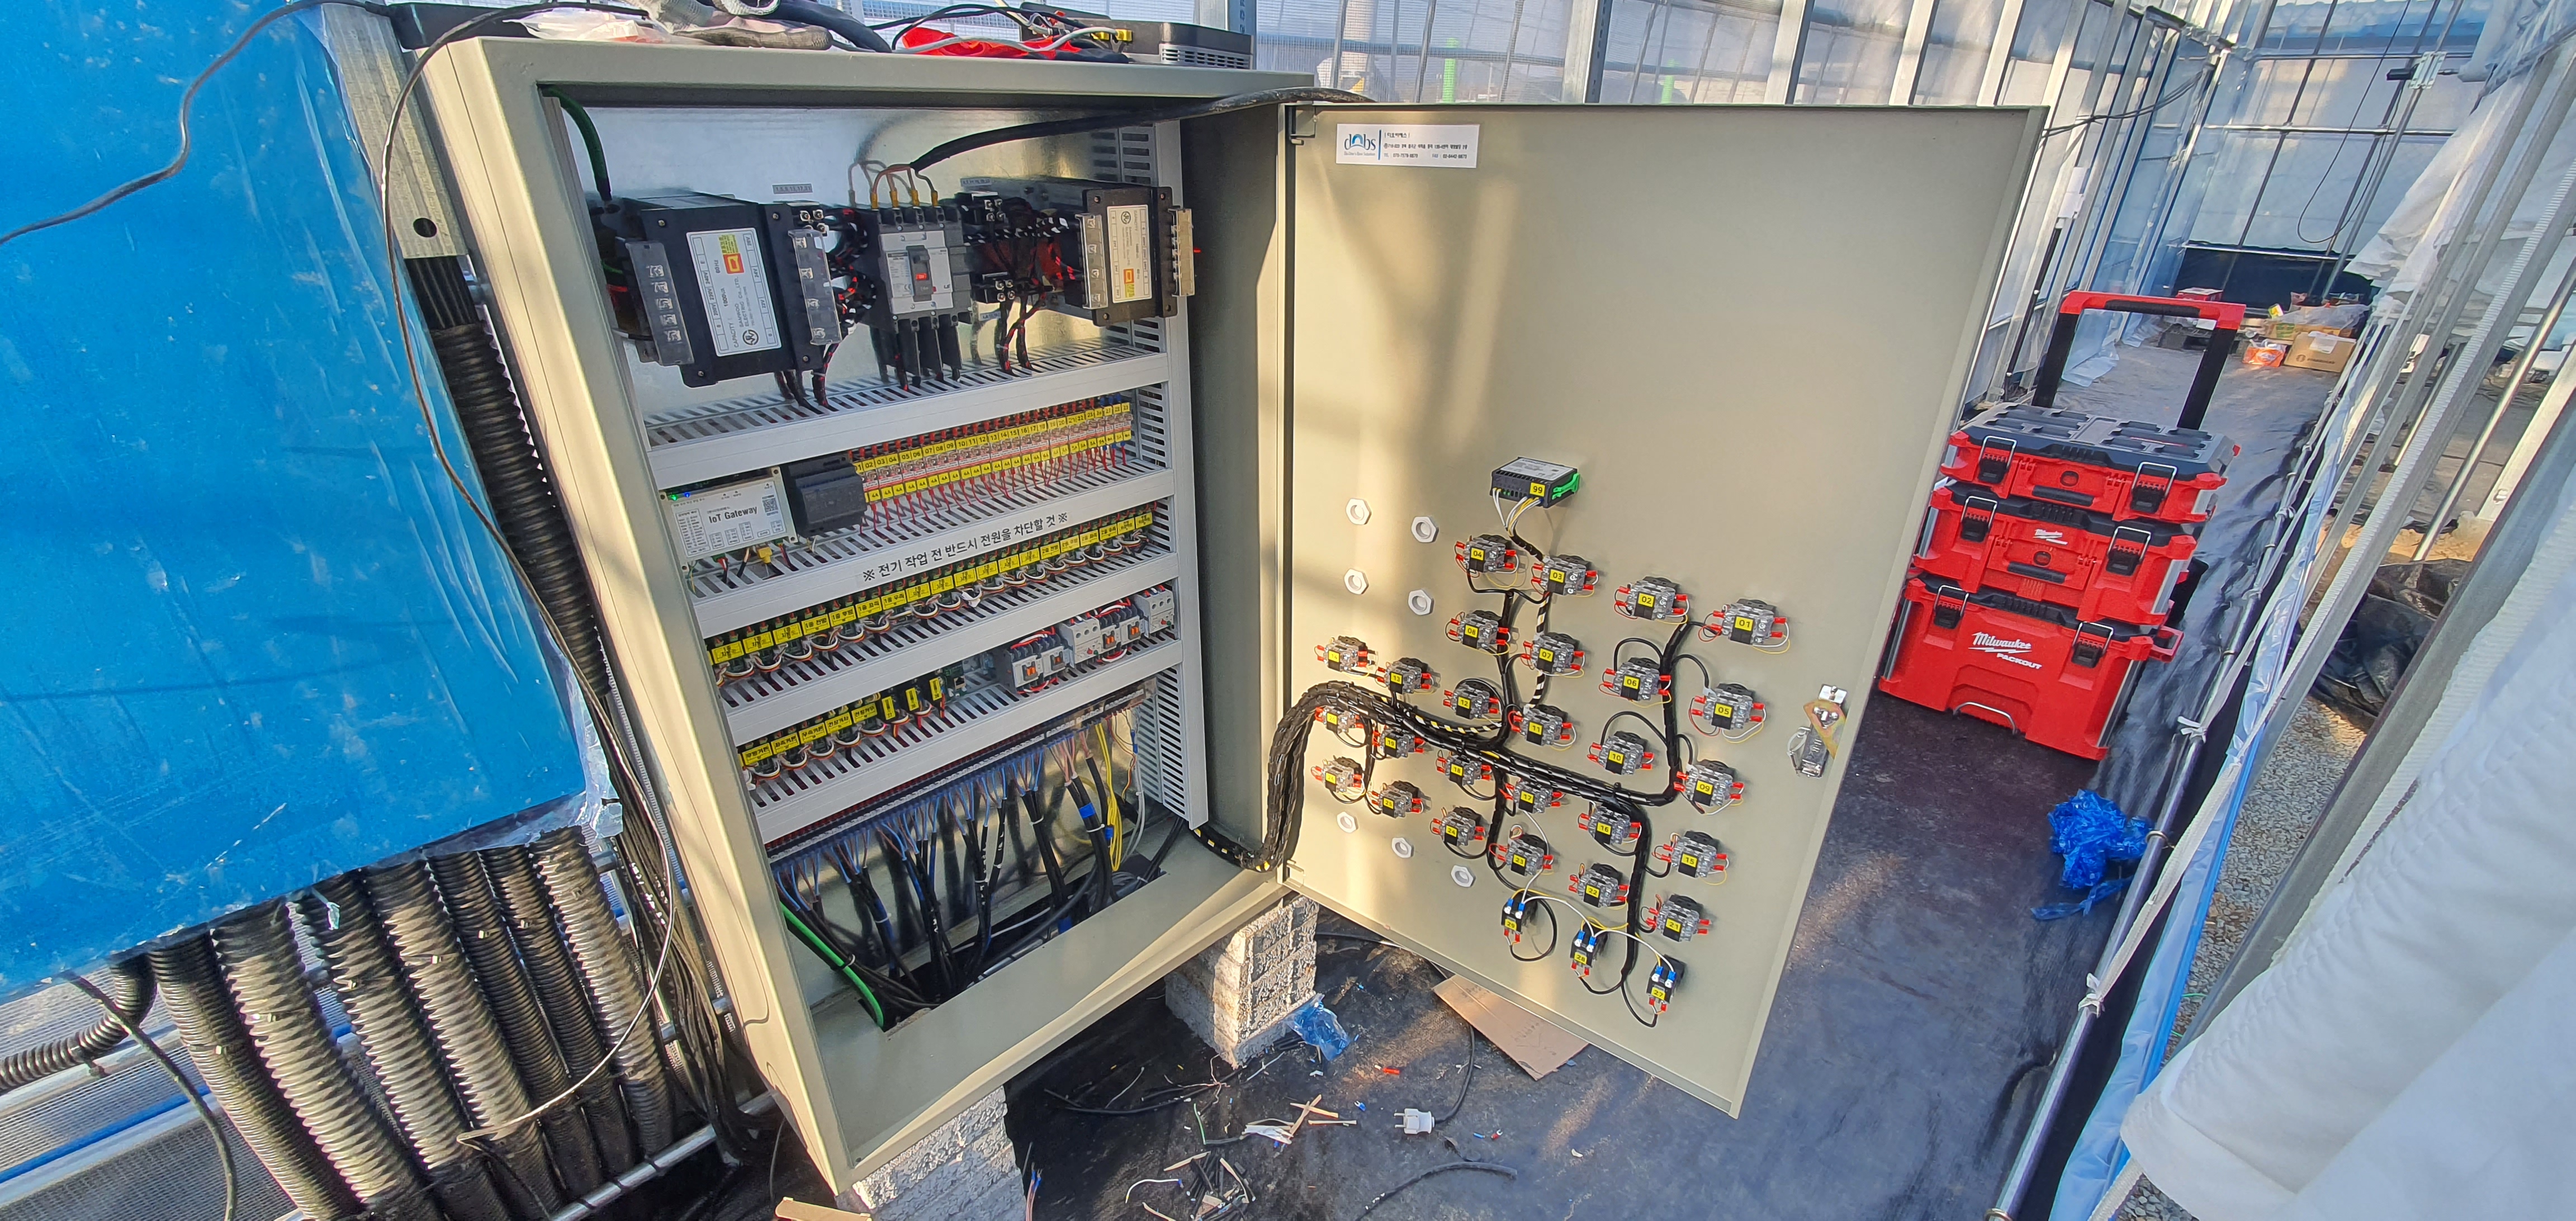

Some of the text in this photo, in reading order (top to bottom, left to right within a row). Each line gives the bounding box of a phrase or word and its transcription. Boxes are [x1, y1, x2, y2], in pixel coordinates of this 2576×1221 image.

[709, 514, 722, 523] IoT
[724, 507, 758, 520] Gateway
[878, 559, 902, 577] 전기
[905, 552, 928, 568] 작업
[931, 548, 943, 561] 전
[945, 538, 978, 557] 반드시
[981, 528, 1011, 547] 전원을
[1014, 518, 1043, 536] 차단할
[1046, 514, 1055, 527] 것
[1641, 596, 1652, 604] 02
[1739, 619, 1750, 628] 01
[1972, 631, 2032, 649] Milwaukee
[1997, 653, 2042, 670] PACKOUT
[1718, 707, 1729, 715] 05
[1700, 784, 1710, 792] 09
